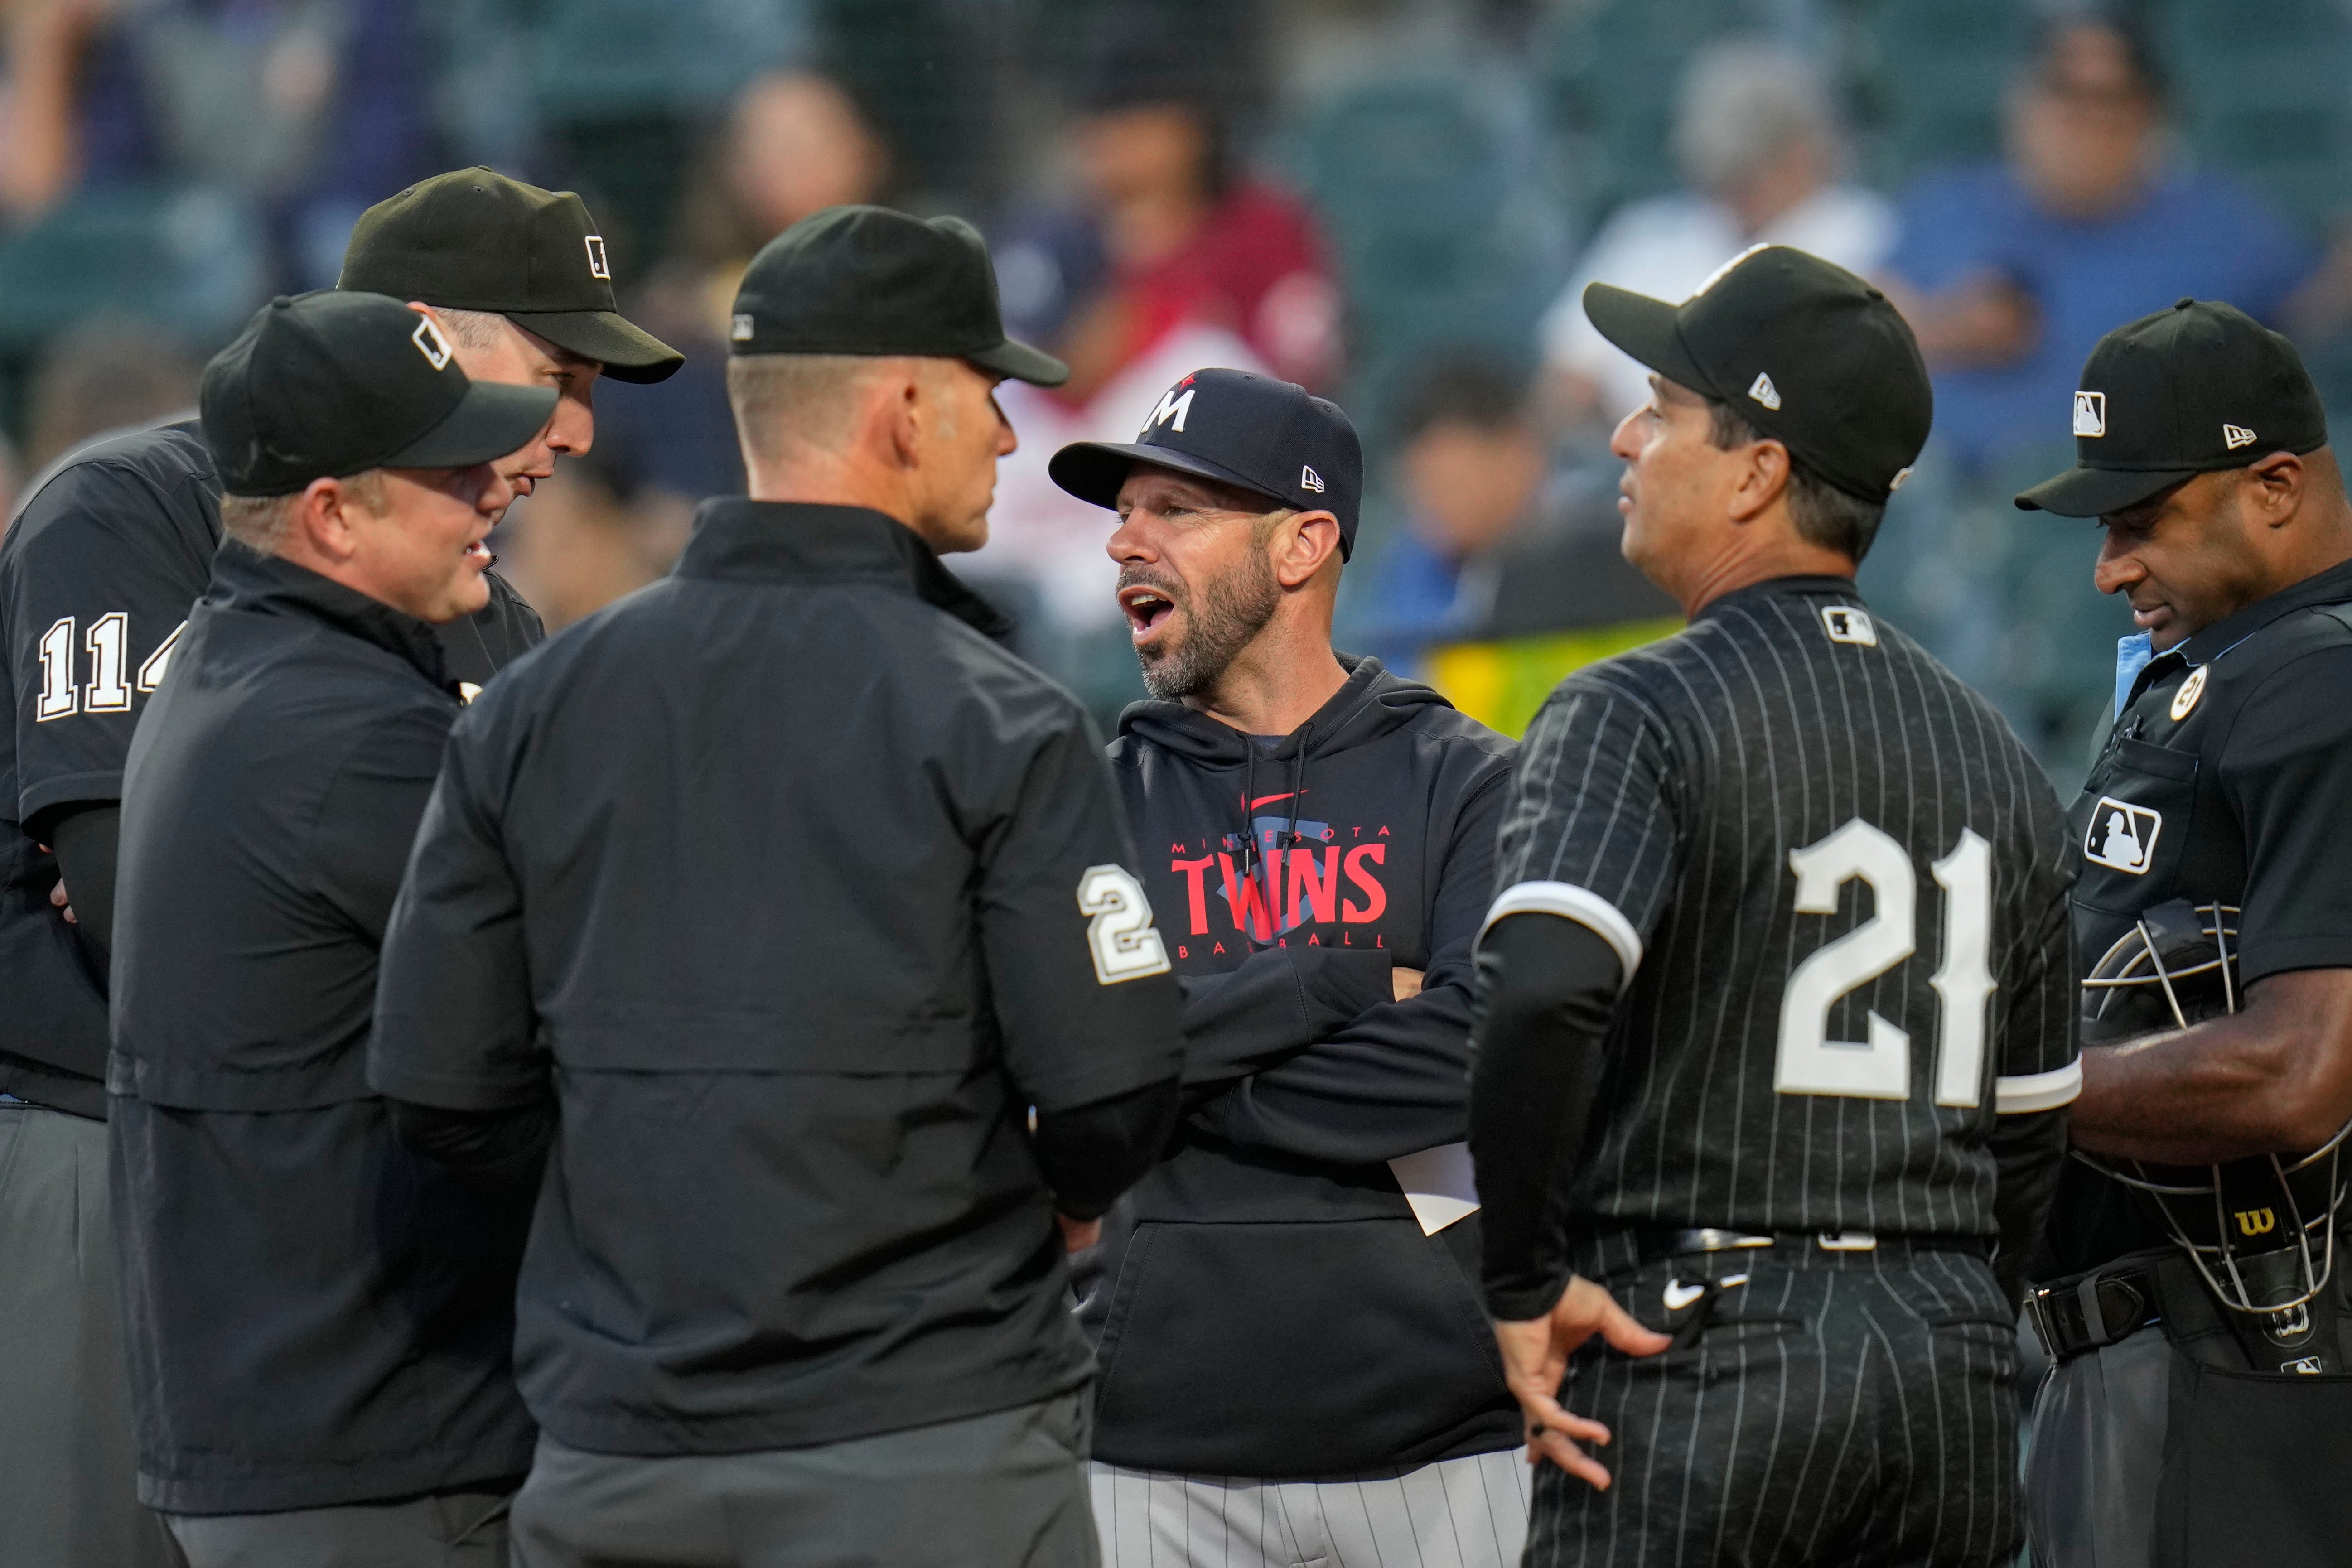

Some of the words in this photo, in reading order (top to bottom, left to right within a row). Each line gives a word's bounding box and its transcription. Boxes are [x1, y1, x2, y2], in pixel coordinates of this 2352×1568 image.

[1140, 389, 1196, 433] M
[1171, 825, 1390, 854] MINESOTA
[1076, 863, 1172, 986] 2
[1171, 843, 1387, 941] TWINS
[1178, 931, 1384, 959] BABALL
[1773, 815, 1998, 1109] 21
